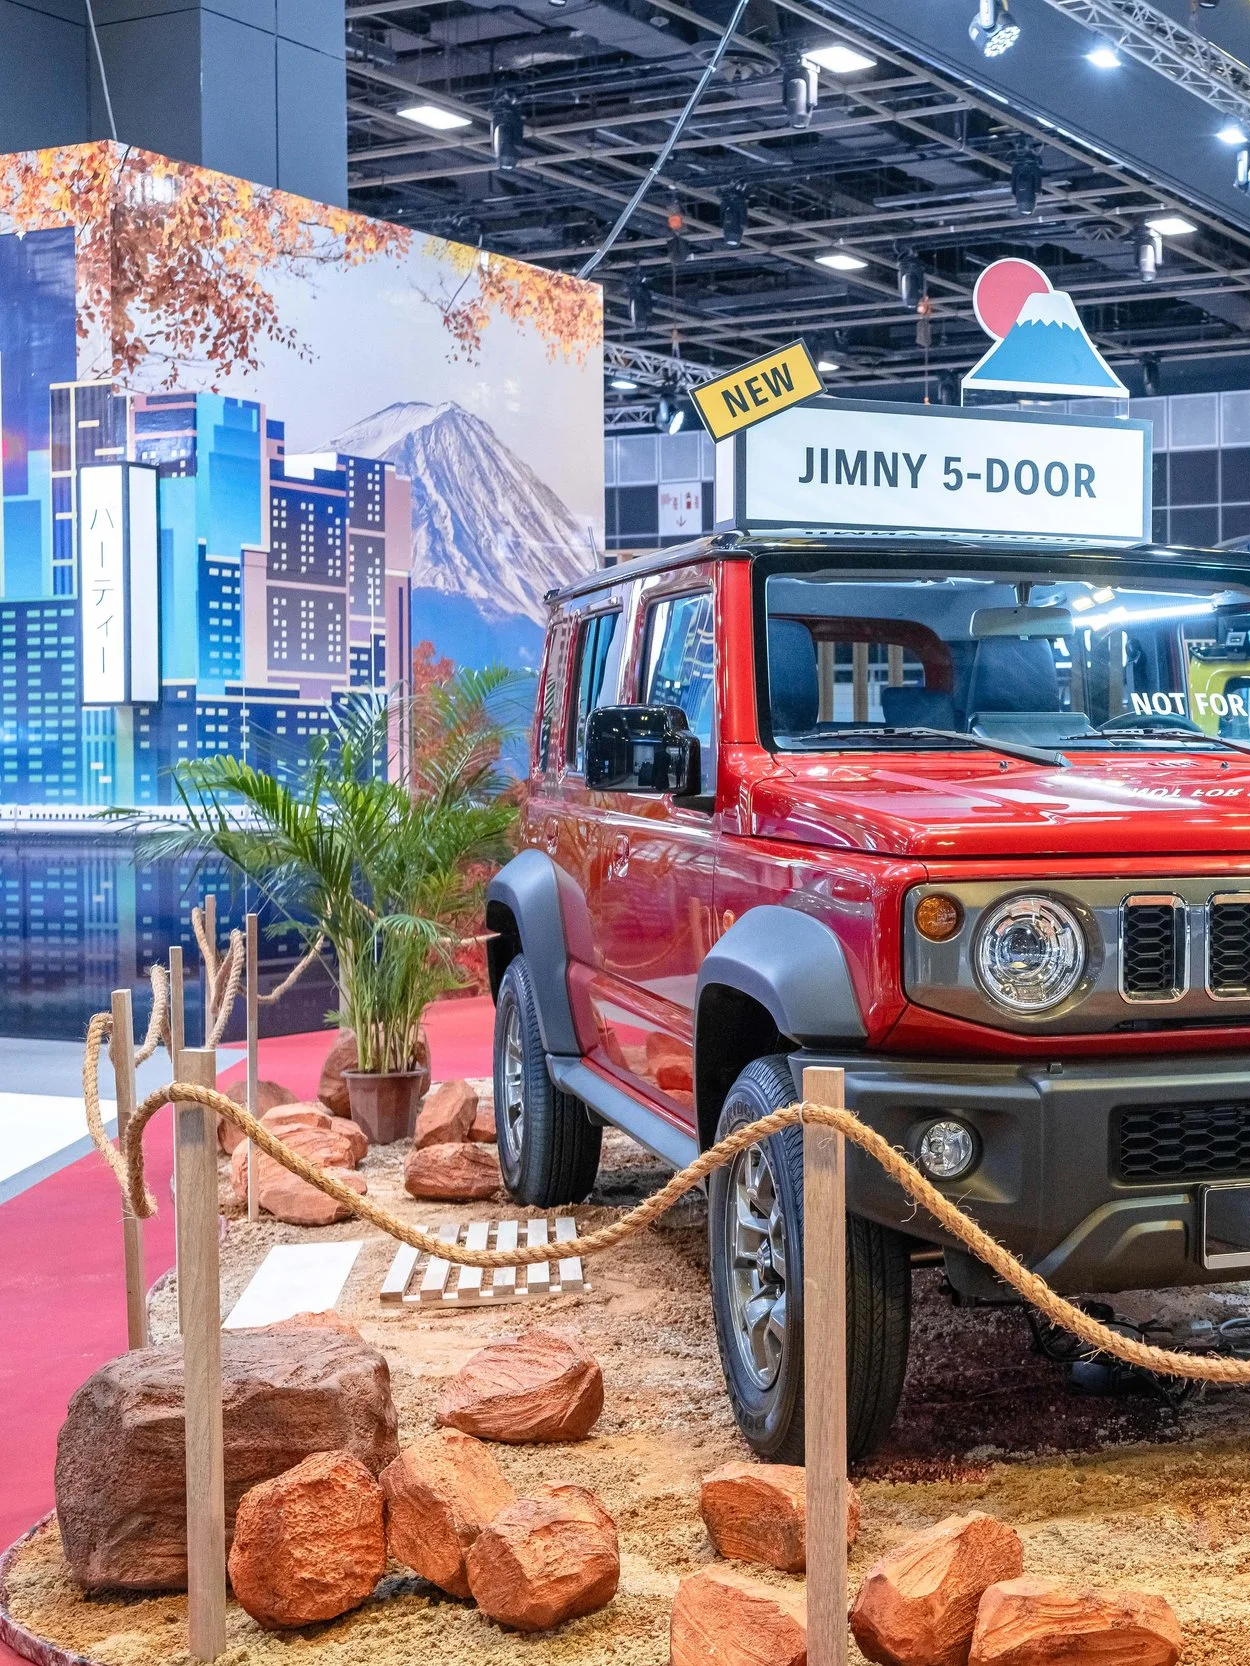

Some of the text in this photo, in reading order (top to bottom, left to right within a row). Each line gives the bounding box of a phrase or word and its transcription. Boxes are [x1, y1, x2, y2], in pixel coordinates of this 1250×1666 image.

[721, 362, 795, 418] NEW
[798, 447, 1097, 499] JIMNY 5-DOOR
[1130, 692, 1187, 716] NOT
[1194, 692, 1249, 717] FOR
